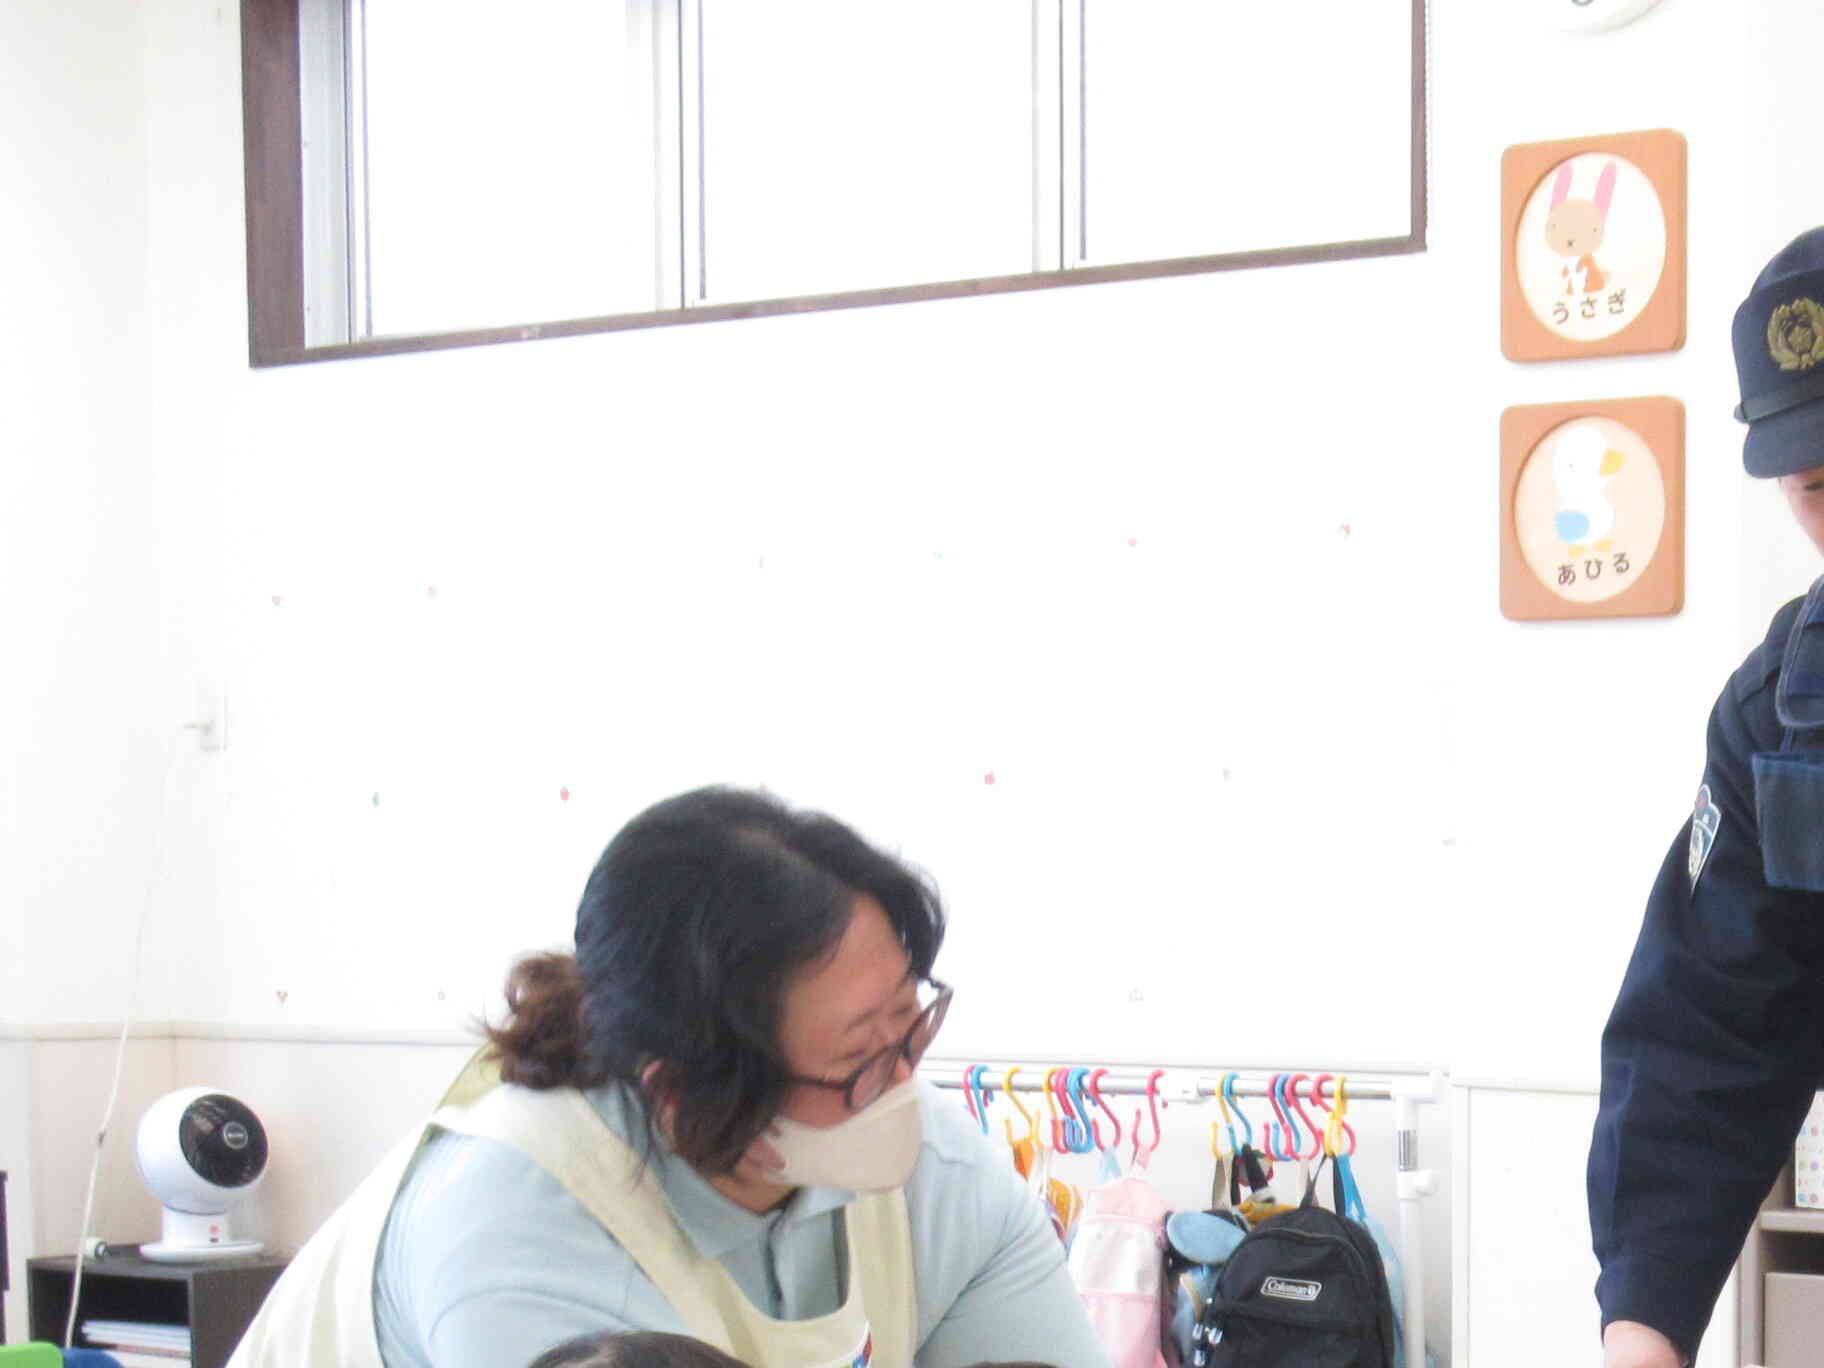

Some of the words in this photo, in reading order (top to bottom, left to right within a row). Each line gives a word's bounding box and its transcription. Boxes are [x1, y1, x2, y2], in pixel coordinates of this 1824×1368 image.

[1552, 288, 1627, 325] うさぎ
[1558, 552, 1630, 585] あひる
